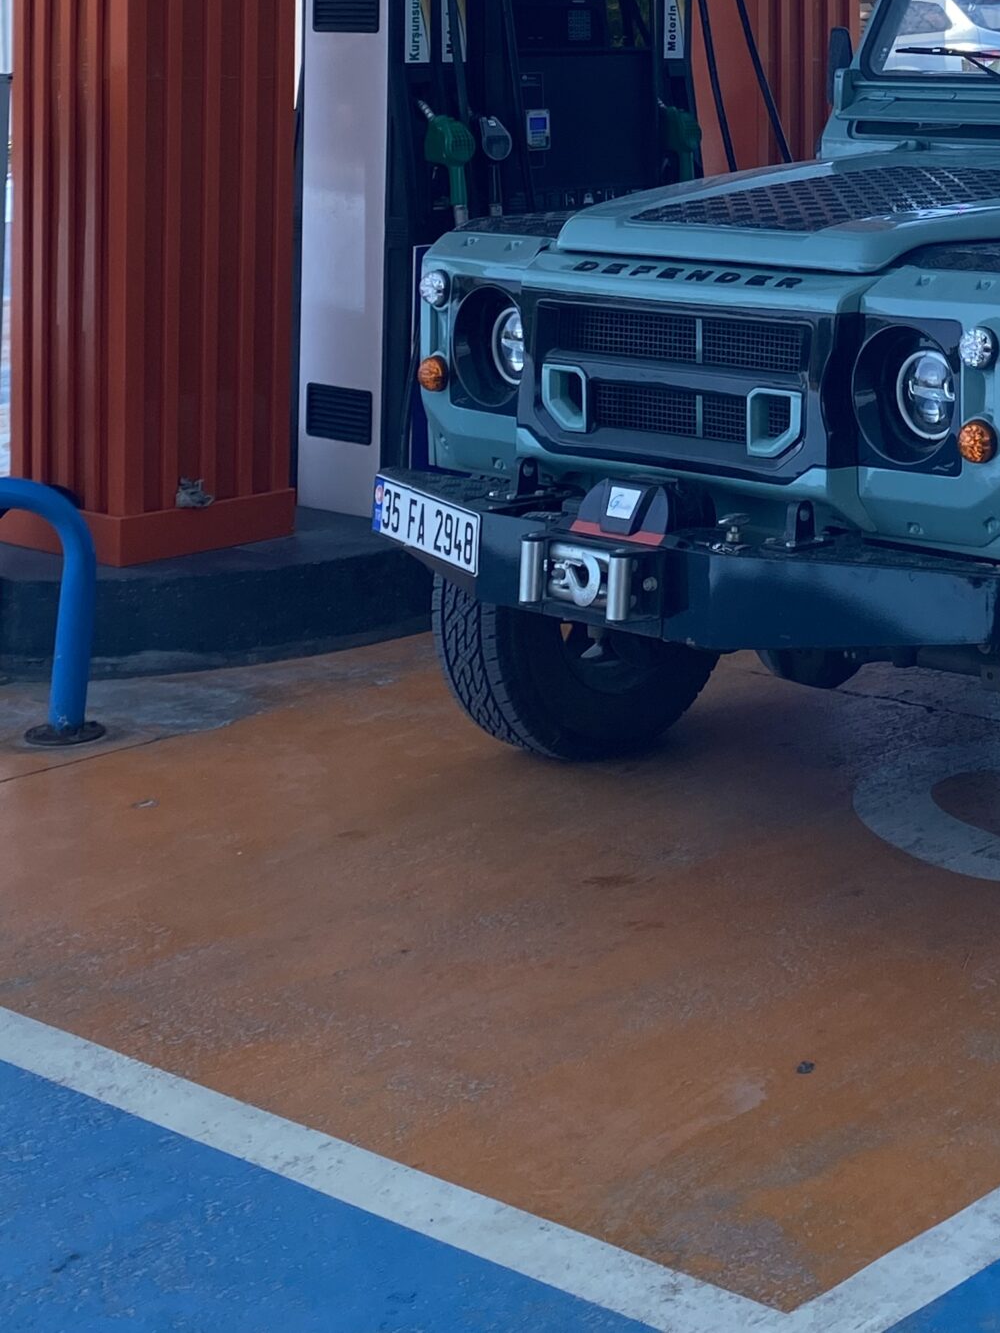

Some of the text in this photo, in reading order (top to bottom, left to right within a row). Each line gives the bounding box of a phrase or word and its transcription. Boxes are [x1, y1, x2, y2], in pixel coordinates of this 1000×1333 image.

[667, 4, 677, 52] Motorin
[572, 260, 804, 289] DEFENDER
[382, 488, 474, 566] 35 FA 2948
